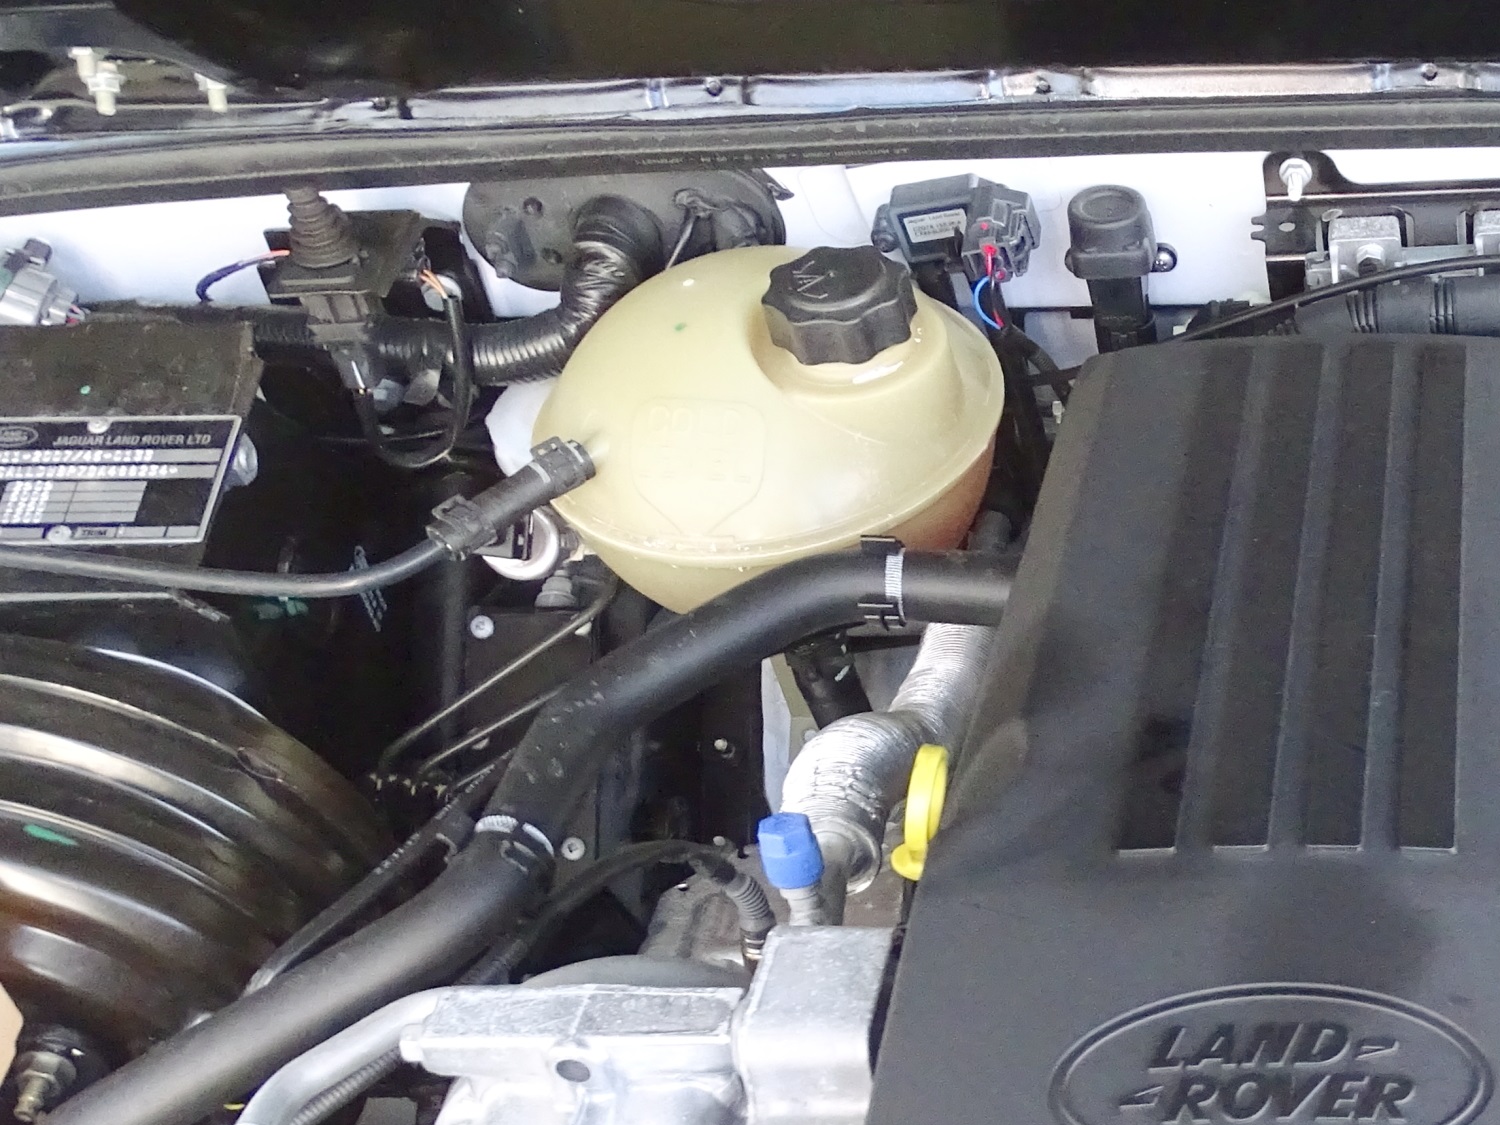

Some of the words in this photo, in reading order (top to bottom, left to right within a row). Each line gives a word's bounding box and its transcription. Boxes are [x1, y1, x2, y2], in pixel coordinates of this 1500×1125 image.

[53, 434, 104, 448] JAGUAR
[105, 435, 140, 446] LAND
[141, 434, 185, 446] ROVER
[186, 433, 212, 446] LTD
[1147, 1021, 1351, 1073] LAND
